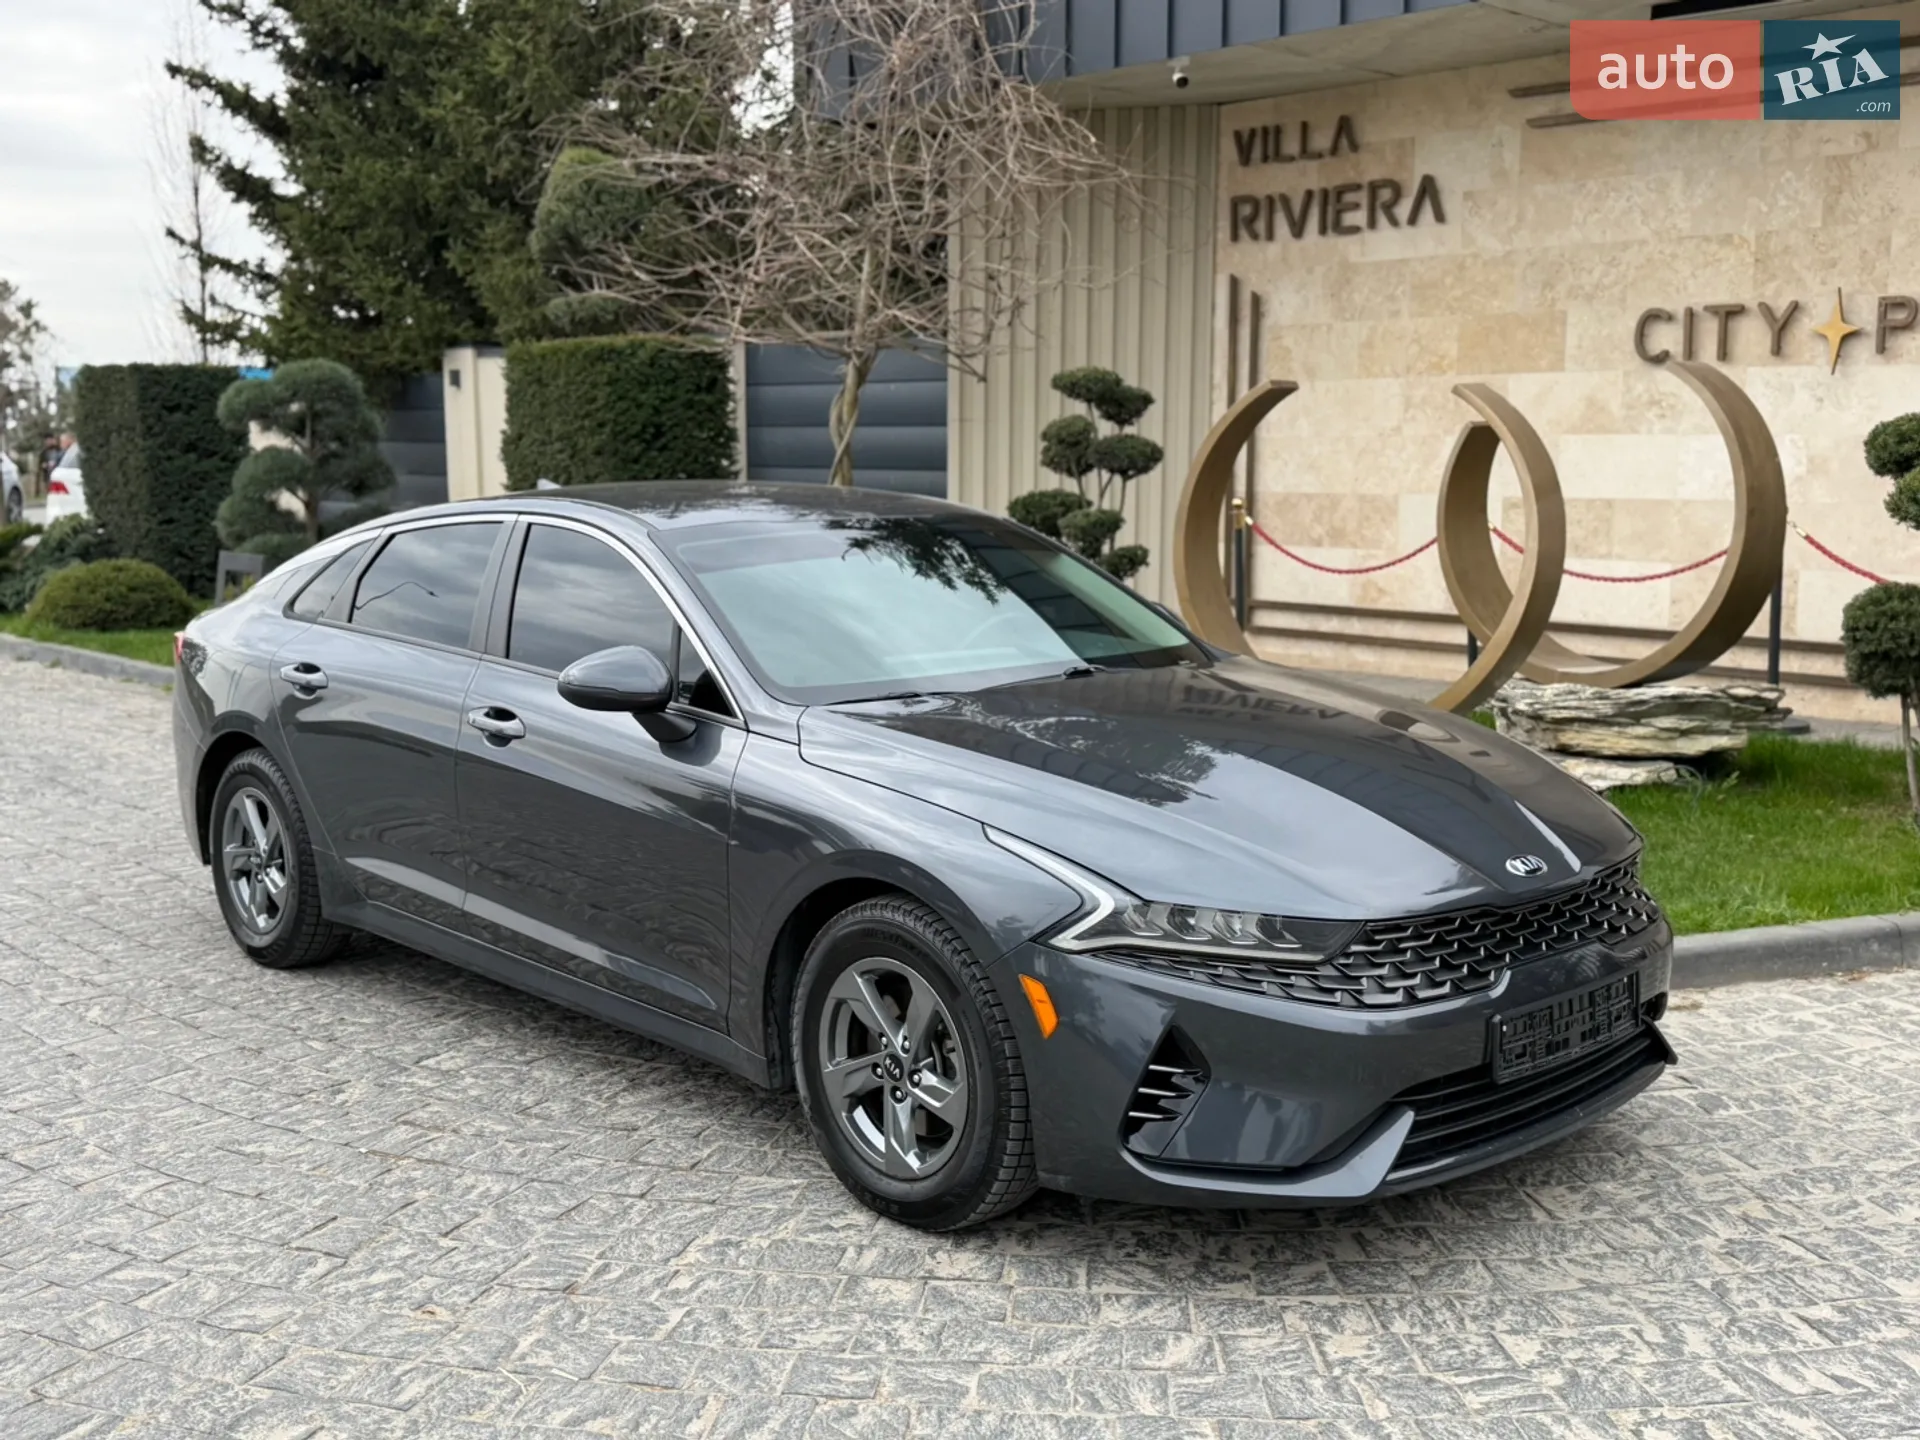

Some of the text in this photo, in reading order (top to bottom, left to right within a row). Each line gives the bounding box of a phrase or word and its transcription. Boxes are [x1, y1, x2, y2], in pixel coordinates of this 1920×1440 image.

[1233, 114, 1360, 167] VILLA
[1229, 173, 1446, 243] RIVIERA
[1634, 299, 1800, 364] CITY
[1509, 856, 1545, 873] KIA
[884, 1056, 900, 1079] KIA
